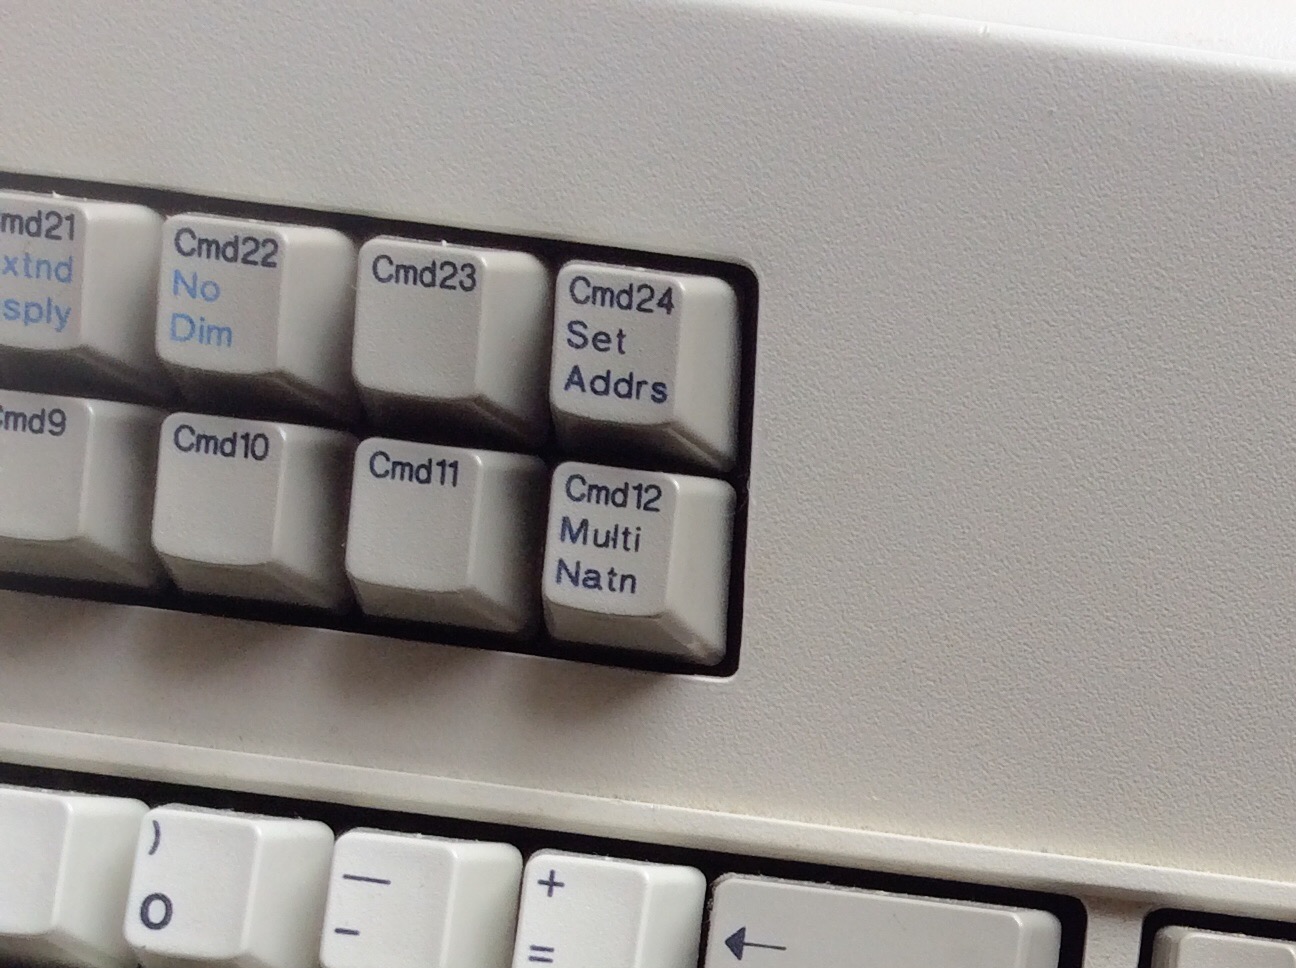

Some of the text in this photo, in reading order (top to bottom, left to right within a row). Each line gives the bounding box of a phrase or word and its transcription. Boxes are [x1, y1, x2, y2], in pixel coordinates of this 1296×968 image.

[0, 210, 74, 240] md21
[175, 228, 278, 268] Cmd22
[0, 253, 73, 283] xtnd
[373, 255, 476, 292] Cmd23
[173, 270, 220, 302] No
[570, 276, 674, 314] Cmd24
[0, 297, 71, 332] sply
[171, 314, 232, 347] Dim
[567, 320, 626, 354] Set
[565, 365, 667, 404] Addrs
[174, 423, 270, 461] Cmd10
[370, 450, 461, 487] Cmd11
[566, 474, 663, 512] Cmd12
[561, 517, 641, 552] Multi
[556, 559, 636, 593] Natn
[149, 820, 160, 855] )
[538, 870, 564, 897] +
[529, 946, 554, 962] =
